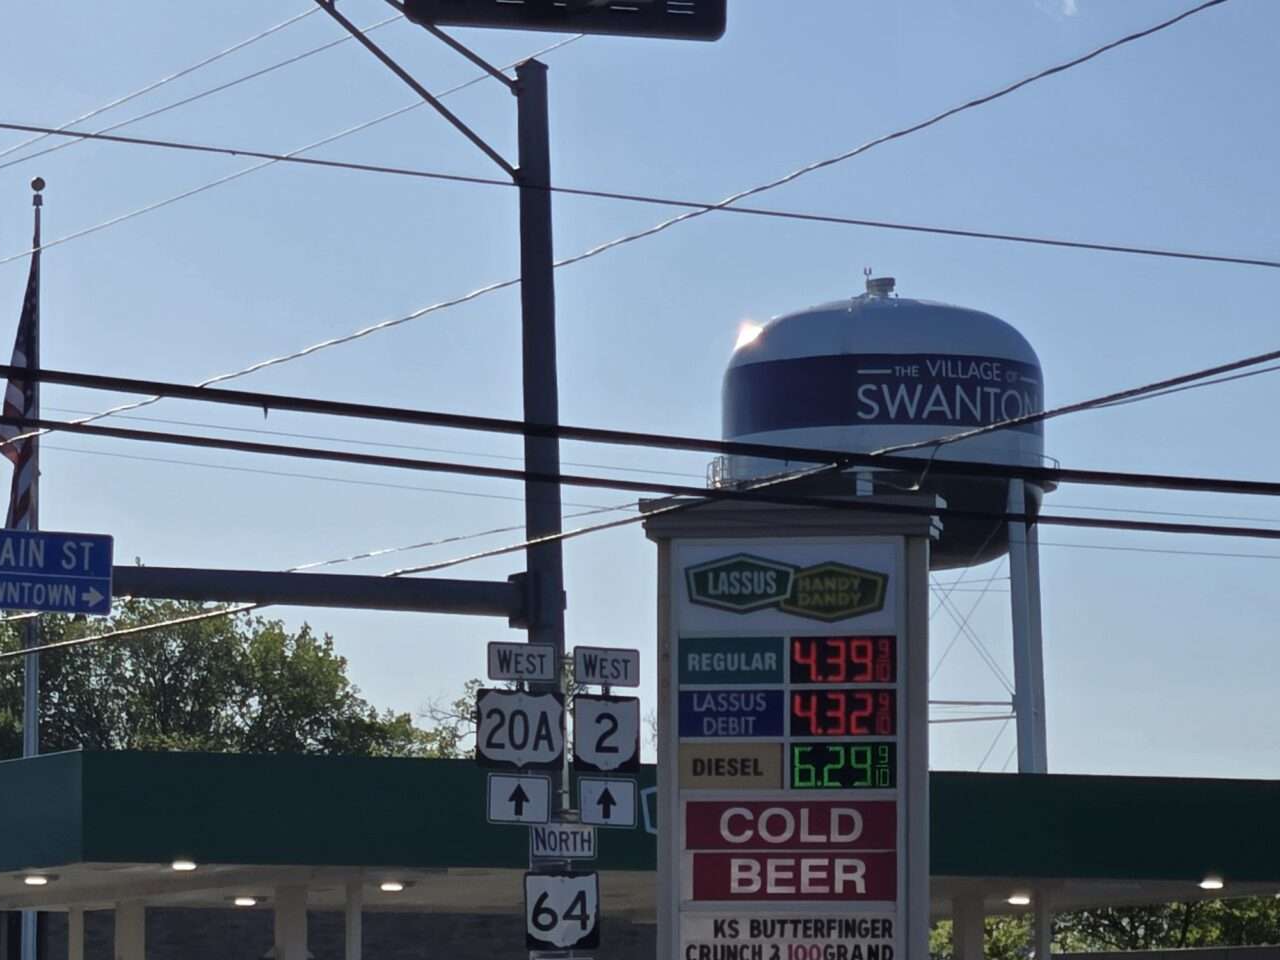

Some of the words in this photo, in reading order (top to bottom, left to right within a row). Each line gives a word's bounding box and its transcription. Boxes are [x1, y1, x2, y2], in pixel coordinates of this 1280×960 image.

[894, 365, 920, 377] THE
[926, 359, 1002, 382] VILLAGE
[856, 383, 1039, 423] SWANTON
[61, 540, 95, 572] ST
[707, 569, 777, 595] LASSUS
[797, 576, 863, 592] HANDY
[797, 592, 863, 607] DANDY
[496, 648, 548, 675] WEST
[583, 653, 632, 681] WEST
[687, 652, 777, 672] REGULAR
[793, 639, 873, 682] 4.39
[692, 692, 767, 713] LASSUS
[793, 692, 873, 735] 4.32
[703, 716, 757, 736] DEBIT
[485, 708, 555, 753] 20A
[595, 712, 620, 754] 2
[692, 758, 764, 777] DIESEL
[793, 745, 873, 787] 6.29
[534, 827, 593, 853] NORTH
[719, 807, 864, 844] COLD
[730, 858, 867, 895] BEER
[532, 890, 590, 932] 64
[713, 919, 740, 939] KS
[749, 918, 894, 939] BUTTERFINGER
